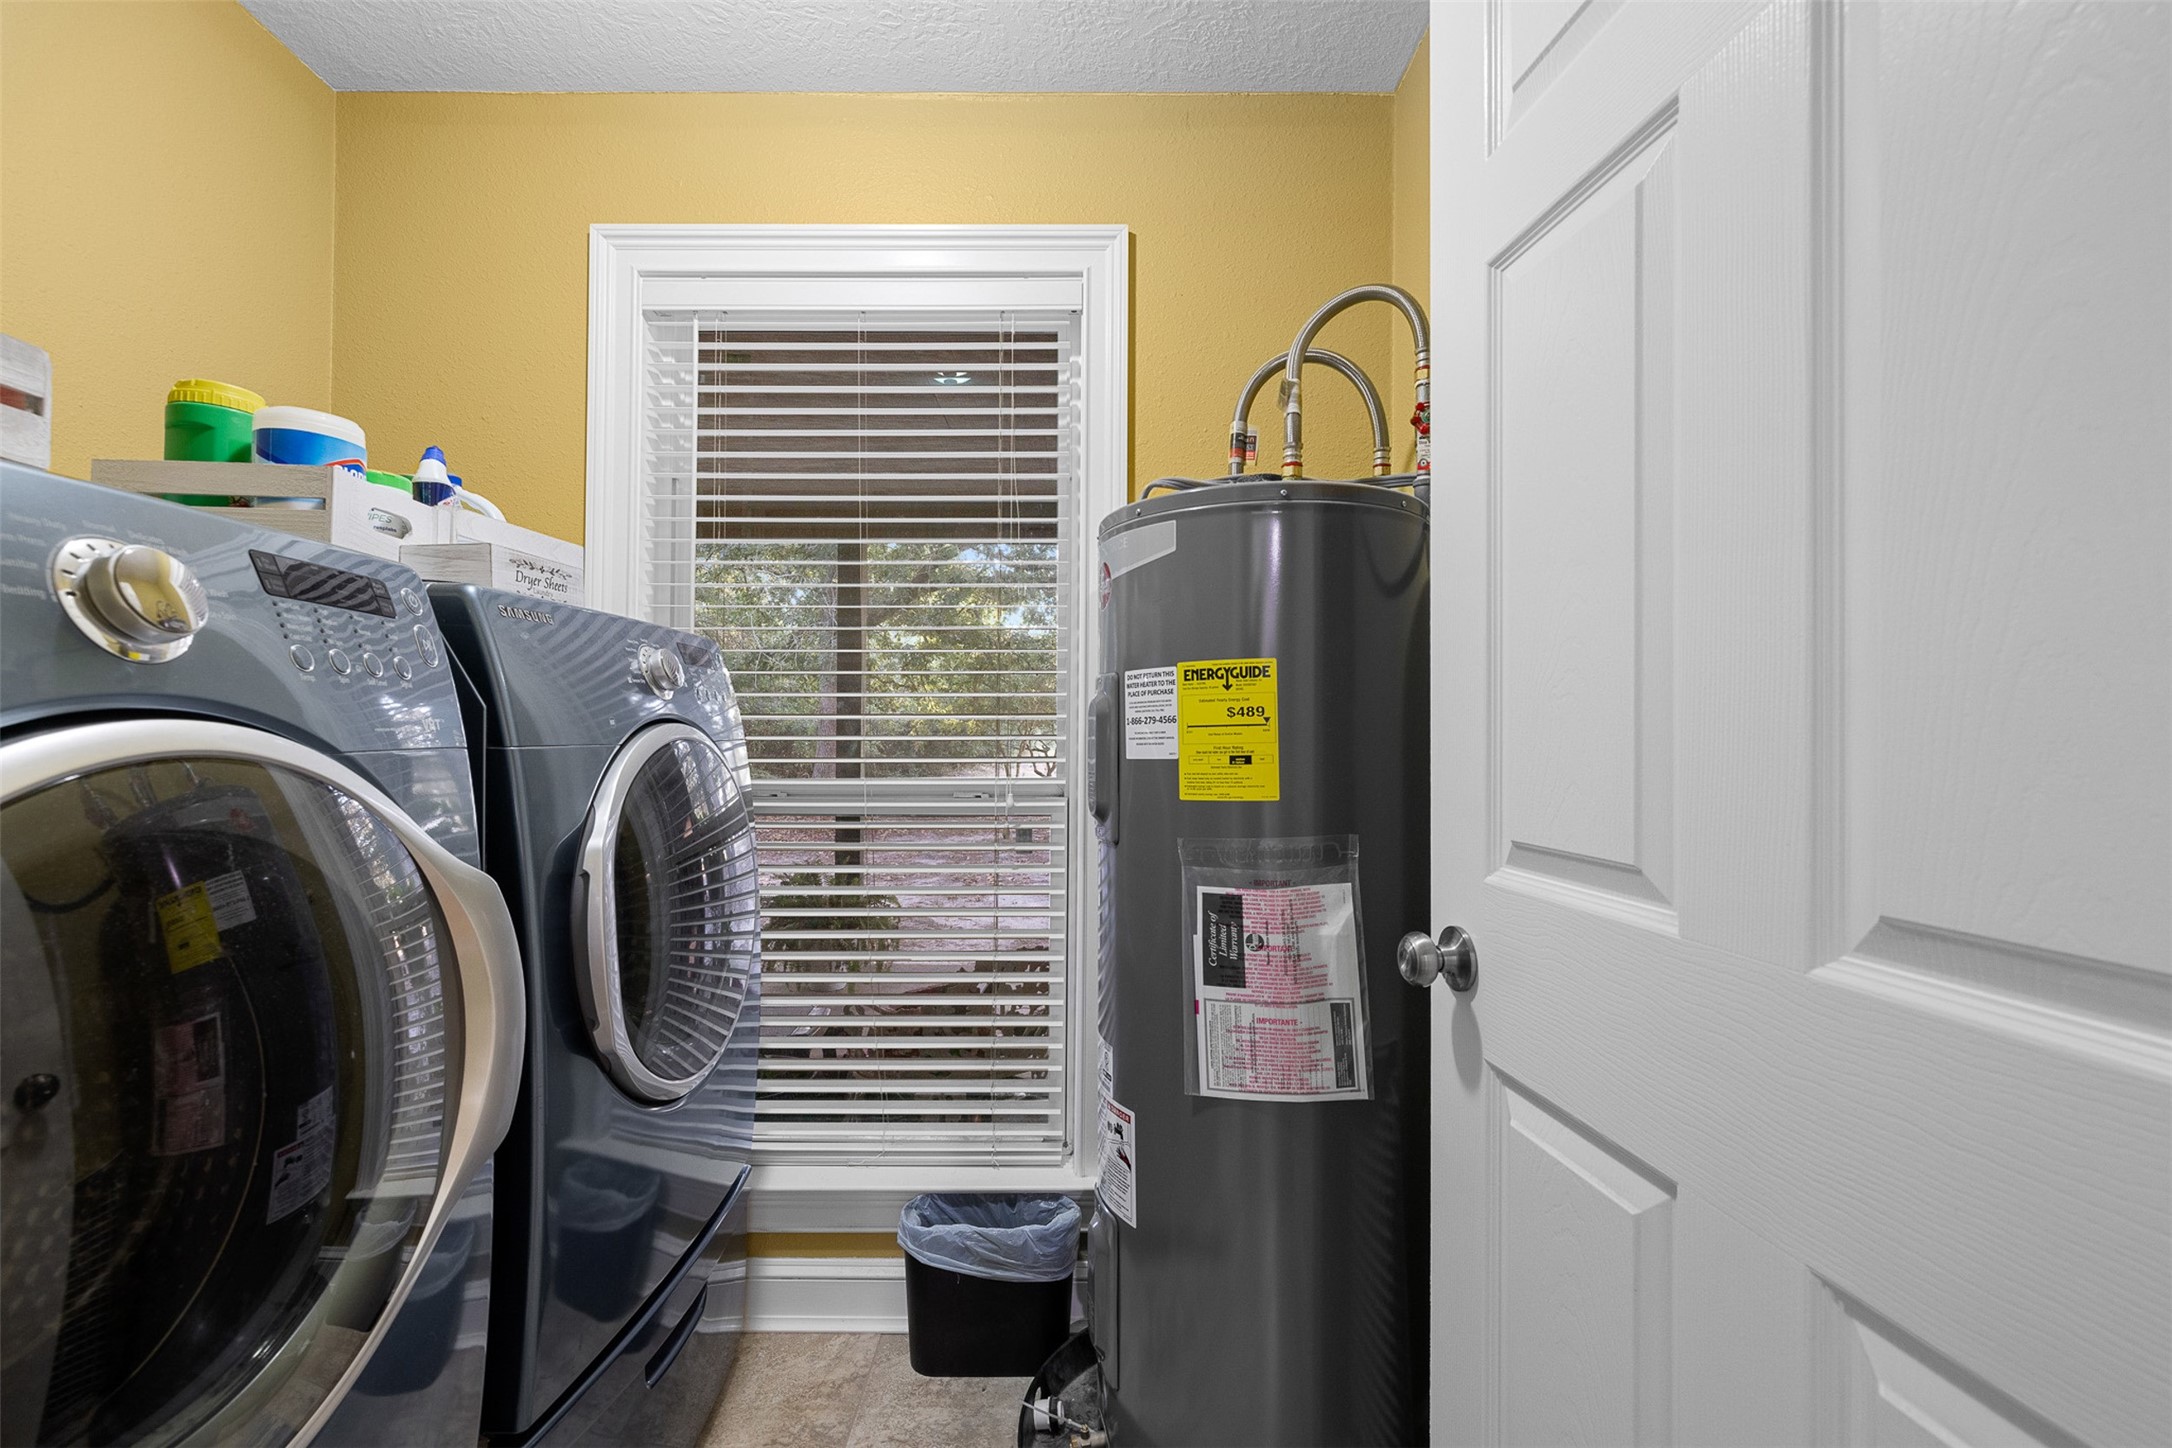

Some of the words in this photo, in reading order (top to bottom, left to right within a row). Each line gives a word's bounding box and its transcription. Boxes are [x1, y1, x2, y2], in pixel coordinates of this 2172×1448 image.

[515, 570, 541, 591] Dryer
[543, 576, 568, 593] Sheets
[497, 604, 555, 626] SAMSUNG
[1163, 670, 1175, 678] THIS
[1183, 665, 1271, 682] ENERGYGUIDE
[1148, 688, 1174, 697] PURCHASE
[1226, 705, 1265, 718] $489
[1126, 715, 1177, 726] 1-866-279-4566
[1252, 879, 1291, 887] IMPORTANT
[1208, 910, 1219, 922] of
[1208, 922, 1218, 967] Certificate
[1218, 923, 1228, 957] Limited
[1229, 921, 1240, 960] Warranty
[1256, 1017, 1298, 1026] IMPORTANTE
